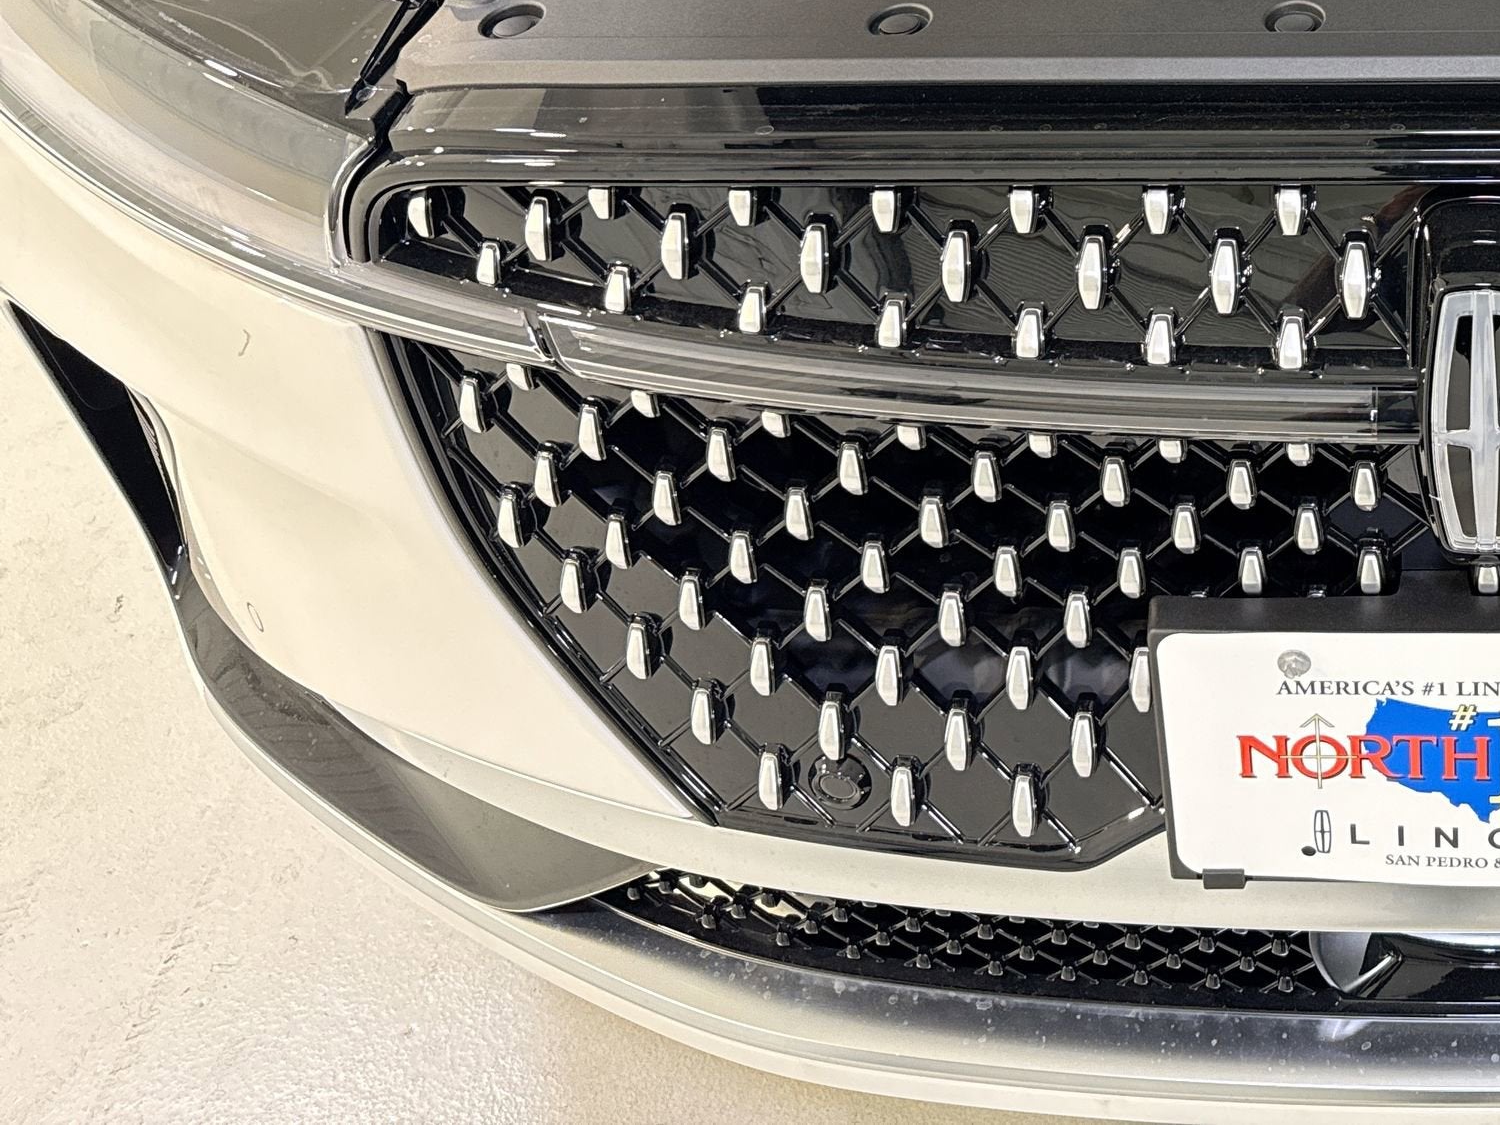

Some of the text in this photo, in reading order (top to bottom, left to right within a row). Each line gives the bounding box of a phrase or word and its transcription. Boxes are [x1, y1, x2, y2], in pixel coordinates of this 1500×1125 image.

[1421, 680, 1448, 696] #1
[1236, 734, 1492, 781] NORTH
[1385, 854, 1421, 867] SAN
[1425, 856, 1488, 869] PEDRO
